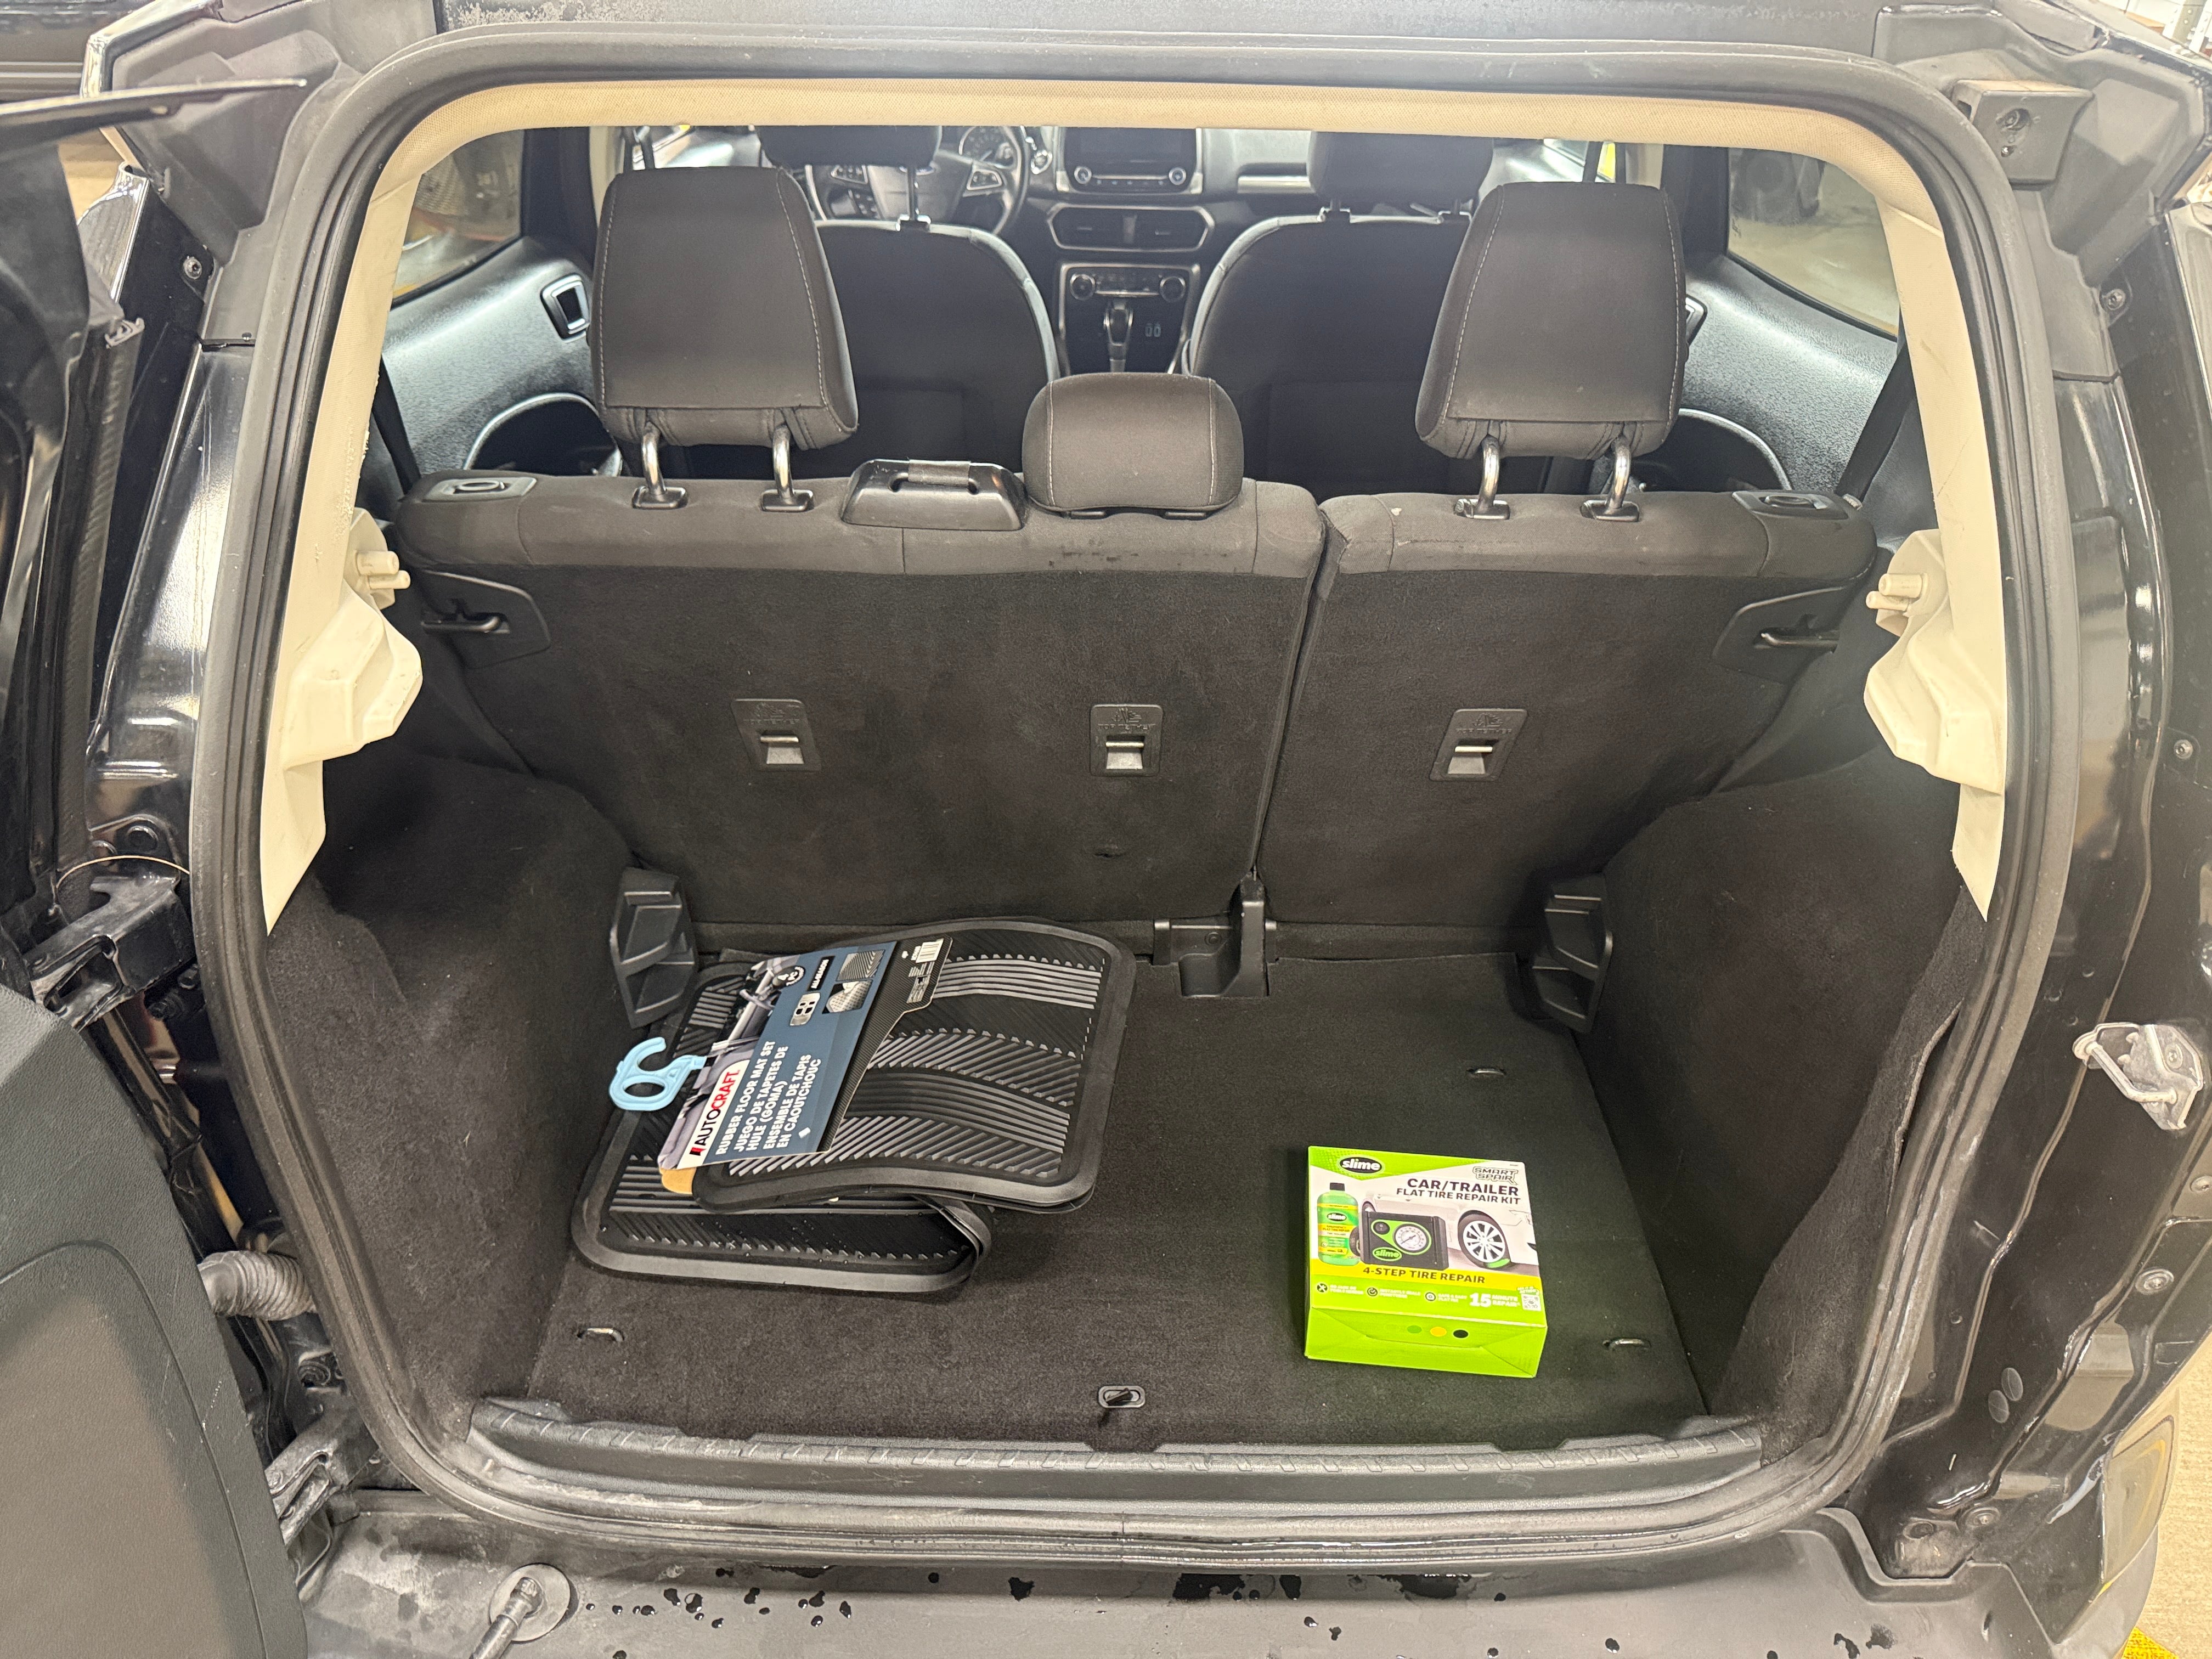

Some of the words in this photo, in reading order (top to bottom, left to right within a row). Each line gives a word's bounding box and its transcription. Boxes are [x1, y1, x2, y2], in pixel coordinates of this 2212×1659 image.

[774, 1046, 788, 1059] DE
[792, 1054, 811, 1082] TAPIS
[757, 1060, 782, 1100] TAPETES
[715, 1114, 743, 1155] RUBBER
[735, 1080, 758, 1114] FLOOR
[750, 1058, 768, 1079] MAT
[760, 1041, 775, 1057] SET
[786, 1083, 800, 1097] DE
[694, 1070, 740, 1146] AUTOCRAFT
[750, 1101, 765, 1115] DE
[776, 1133, 792, 1148] EN
[784, 1058, 821, 1131] CAOUTCHOUC
[746, 1125, 767, 1151] HULE
[759, 1081, 788, 1122] (GOMA)
[763, 1097, 794, 1149] ENSEMBLE
[733, 1116, 757, 1152] JUEGO
[1341, 1158, 1381, 1171] slime
[1474, 1167, 1516, 1176] SMART
[1477, 1173, 1516, 1183] SPAIR
[1407, 1178, 1519, 1197] CAR/TRAILER
[1396, 1188, 1425, 1197] FLAT
[1427, 1190, 1453, 1199] TIRE
[1456, 1193, 1499, 1203] REPAIR
[1501, 1196, 1521, 1204] KIT
[1375, 1249, 1401, 1258] slime
[1363, 1267, 1406, 1277] 4-STEP
[1409, 1270, 1437, 1279] TIRE
[1440, 1272, 1486, 1283] REPAIR
[1469, 1292, 1492, 1308] 15
